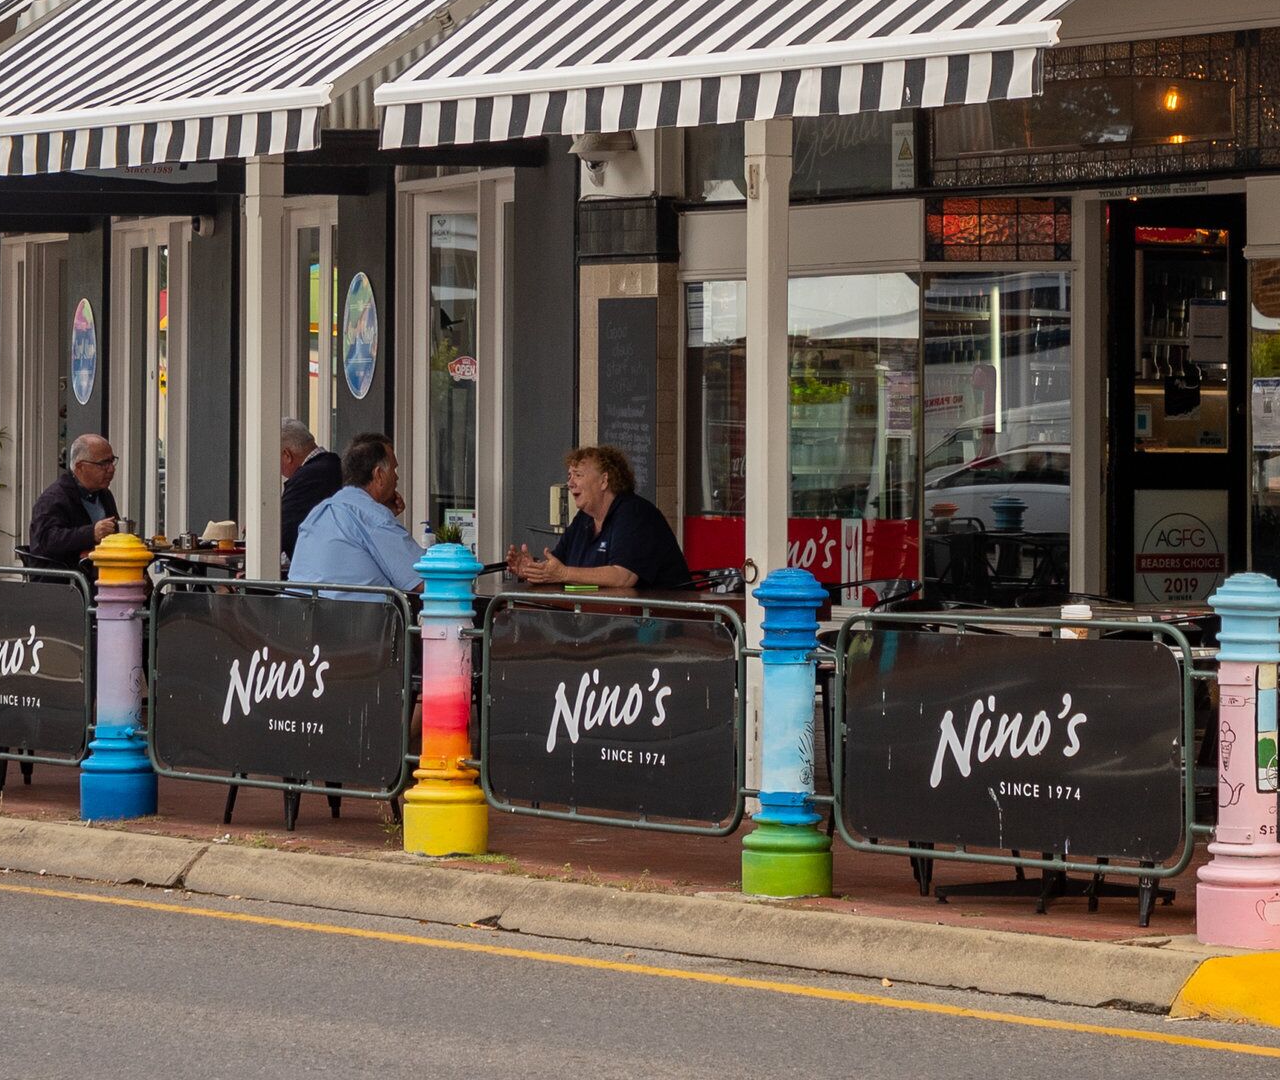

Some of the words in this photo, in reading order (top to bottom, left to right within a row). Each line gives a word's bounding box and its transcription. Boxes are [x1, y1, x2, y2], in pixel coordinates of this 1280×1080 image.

[124, 166, 150, 174] Since
[455, 365, 475, 375] OPEN
[1156, 529, 1206, 547] AGFG
[787, 526, 836, 569] no's
[1141, 558, 1180, 568] READERS
[1183, 558, 1220, 568] CHOICE
[1164, 578, 1199, 593] 2019
[222, 644, 330, 725] Nino's
[22, 695, 41, 709] 1974
[546, 667, 672, 753] Nino's
[268, 719, 297, 732] SINCE
[300, 721, 324, 735] 1974
[929, 693, 1087, 789] Nino's
[600, 748, 634, 764] SINCE
[638, 751, 667, 766] 1974
[999, 781, 1041, 799] SINCE
[1047, 784, 1082, 801] 1974
